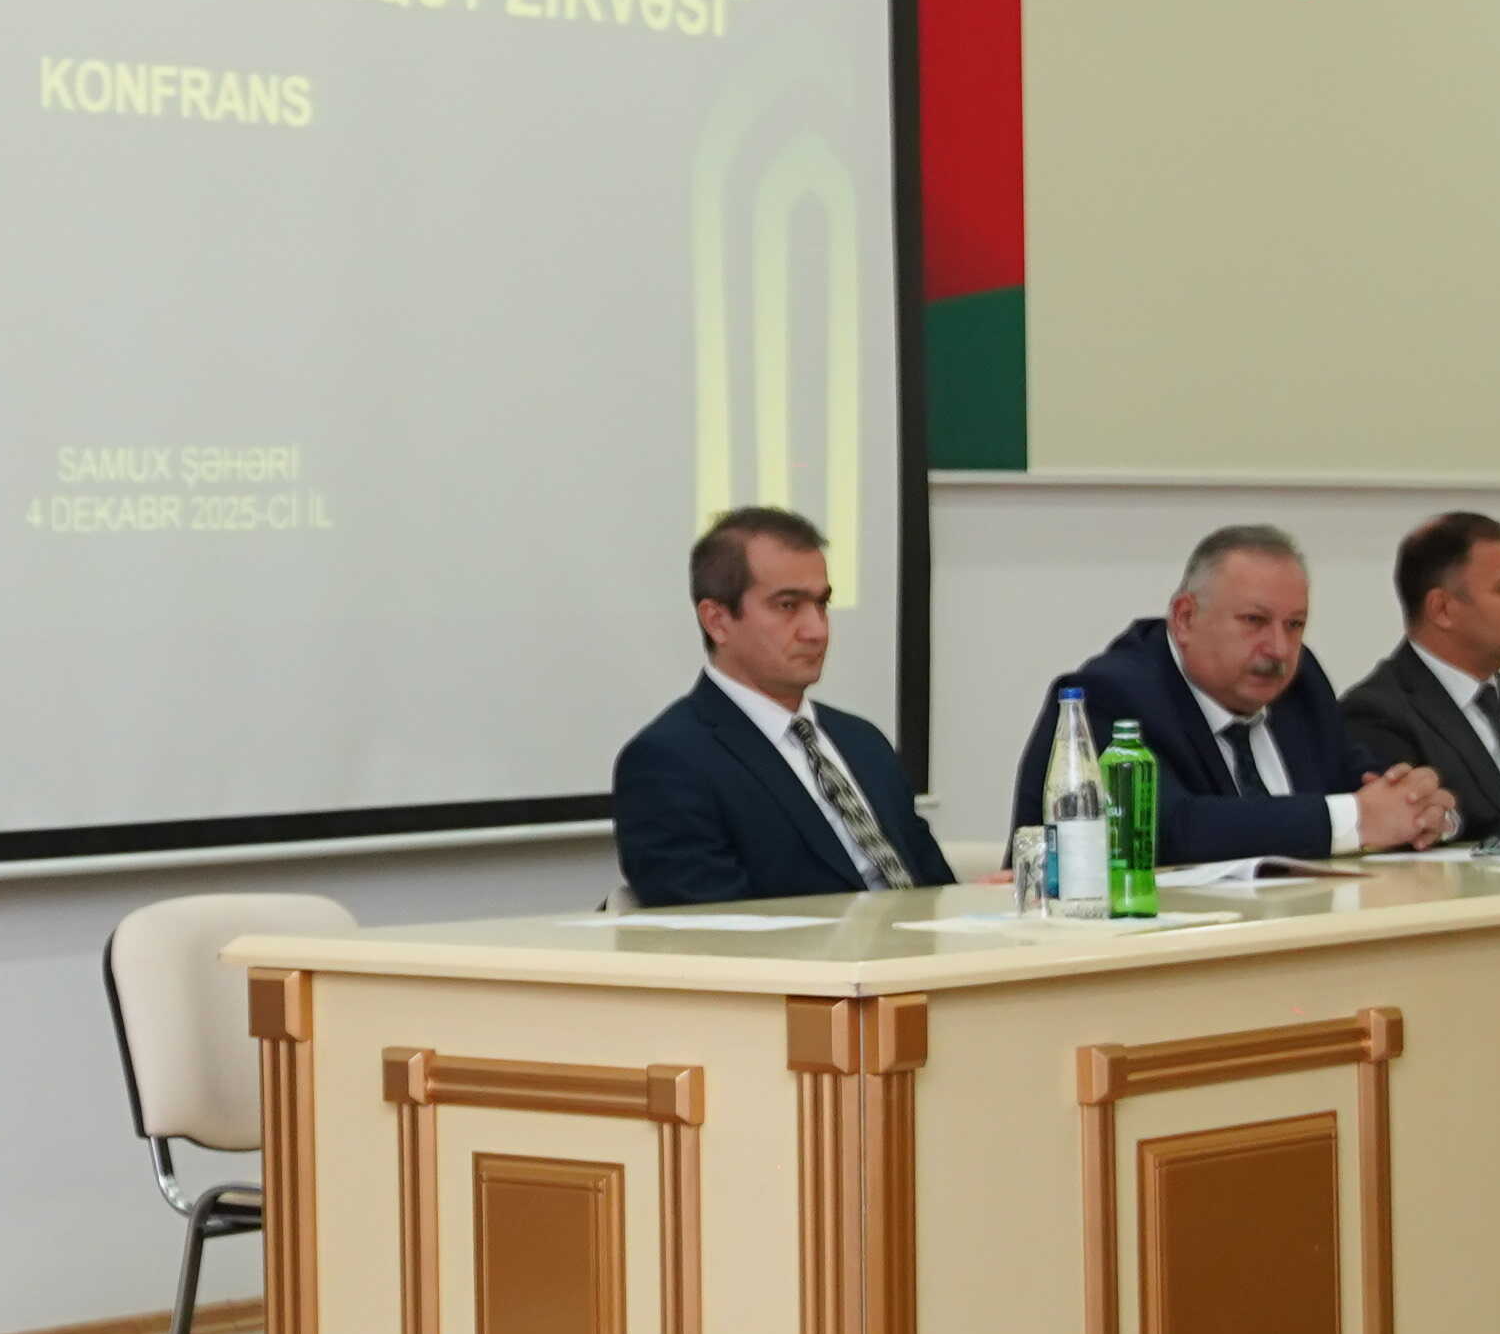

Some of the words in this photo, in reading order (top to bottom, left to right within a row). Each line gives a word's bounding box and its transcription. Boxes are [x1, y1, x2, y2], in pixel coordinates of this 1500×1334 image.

[40, 56, 312, 127] KONFRANS
[56, 444, 174, 484] SAMUX
[179, 441, 303, 490] ŞƏHƏRİ
[25, 495, 44, 528] 4
[51, 494, 184, 533] DEKABR
